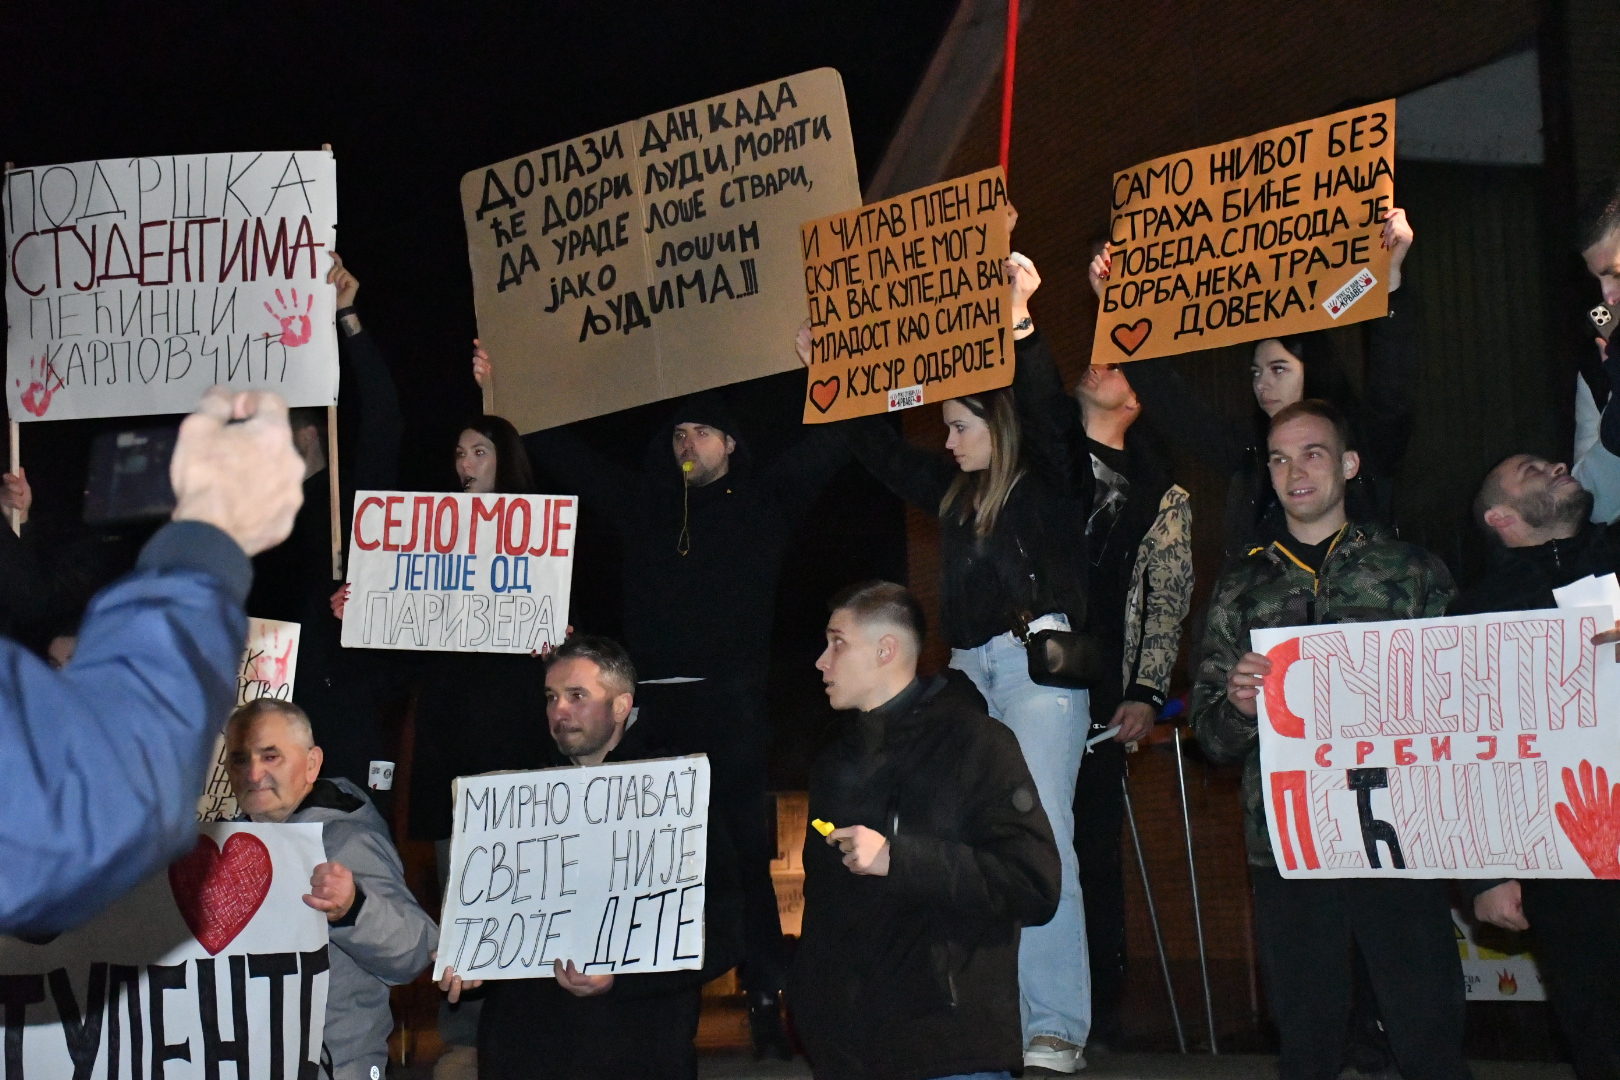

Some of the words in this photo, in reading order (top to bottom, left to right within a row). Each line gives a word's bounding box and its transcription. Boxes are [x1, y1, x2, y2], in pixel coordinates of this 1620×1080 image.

[475, 130, 624, 221] ДОЛАЗИ
[709, 81, 798, 133] КАДА
[542, 173, 633, 235] ДОБРИ
[735, 115, 831, 166] МОРАТИ
[1112, 158, 1194, 210] САМО
[1210, 128, 1313, 185] ЖИВОТ
[1328, 112, 1388, 157] БЕЗ
[8, 153, 316, 234] ПОДРШКА
[802, 226, 819, 260] И
[830, 203, 906, 251] ЧИТАВ
[911, 183, 970, 231] ПЛЕН
[977, 176, 1007, 214] ДА
[1110, 197, 1212, 247] СТРАХА
[1222, 173, 1301, 223] БИЋЕ
[1314, 156, 1394, 200] НАША
[1221, 206, 1349, 257] СЛОБОДА
[1359, 195, 1390, 228] ЈЕ
[12, 215, 325, 296] СТУДЕНТИМА
[496, 243, 541, 293] ДА
[552, 212, 630, 264] УРАДЕ
[645, 189, 707, 233] ЛОШЕ
[720, 164, 813, 208] СТВАРИ,
[868, 248, 900, 280] ПА
[903, 237, 926, 271] НЕ
[932, 223, 987, 264] МОГУ
[809, 295, 841, 327] ДА
[847, 283, 882, 320] ВАС
[938, 267, 973, 300] ДА
[1195, 261, 1262, 299] НЕКА
[1268, 235, 1370, 282] ТРАЈЕ
[29, 286, 238, 339] ПЕЋИНЦИ
[811, 320, 890, 364] МЛАДОСТ
[898, 312, 930, 345] КАО
[936, 297, 1000, 335] СИТАН
[1173, 279, 1317, 340] ДОВЕКА!
[46, 332, 288, 389] КАРЛОВЧИЋ
[847, 358, 905, 398] КУСУР
[354, 496, 460, 554] СЕЛО
[468, 496, 572, 557] МОЈЕ
[389, 554, 477, 591] ЛЕПШЕ
[490, 555, 532, 593] ОД
[363, 591, 557, 649] ПАРИЗЕРА
[1264, 616, 1597, 740] СТУДЕНТИ
[1314, 734, 1541, 768] СРБИЈЕ
[463, 782, 571, 833] МИРНО
[584, 767, 697, 824] СПАВАЈ
[1270, 760, 1563, 871] ПЕЋИНЦИ
[460, 834, 580, 906] СВЕТЕ
[609, 823, 703, 893] НИЈЕ
[453, 909, 572, 973] ТВОЈЕ
[583, 882, 703, 974] ДЕТЕ
